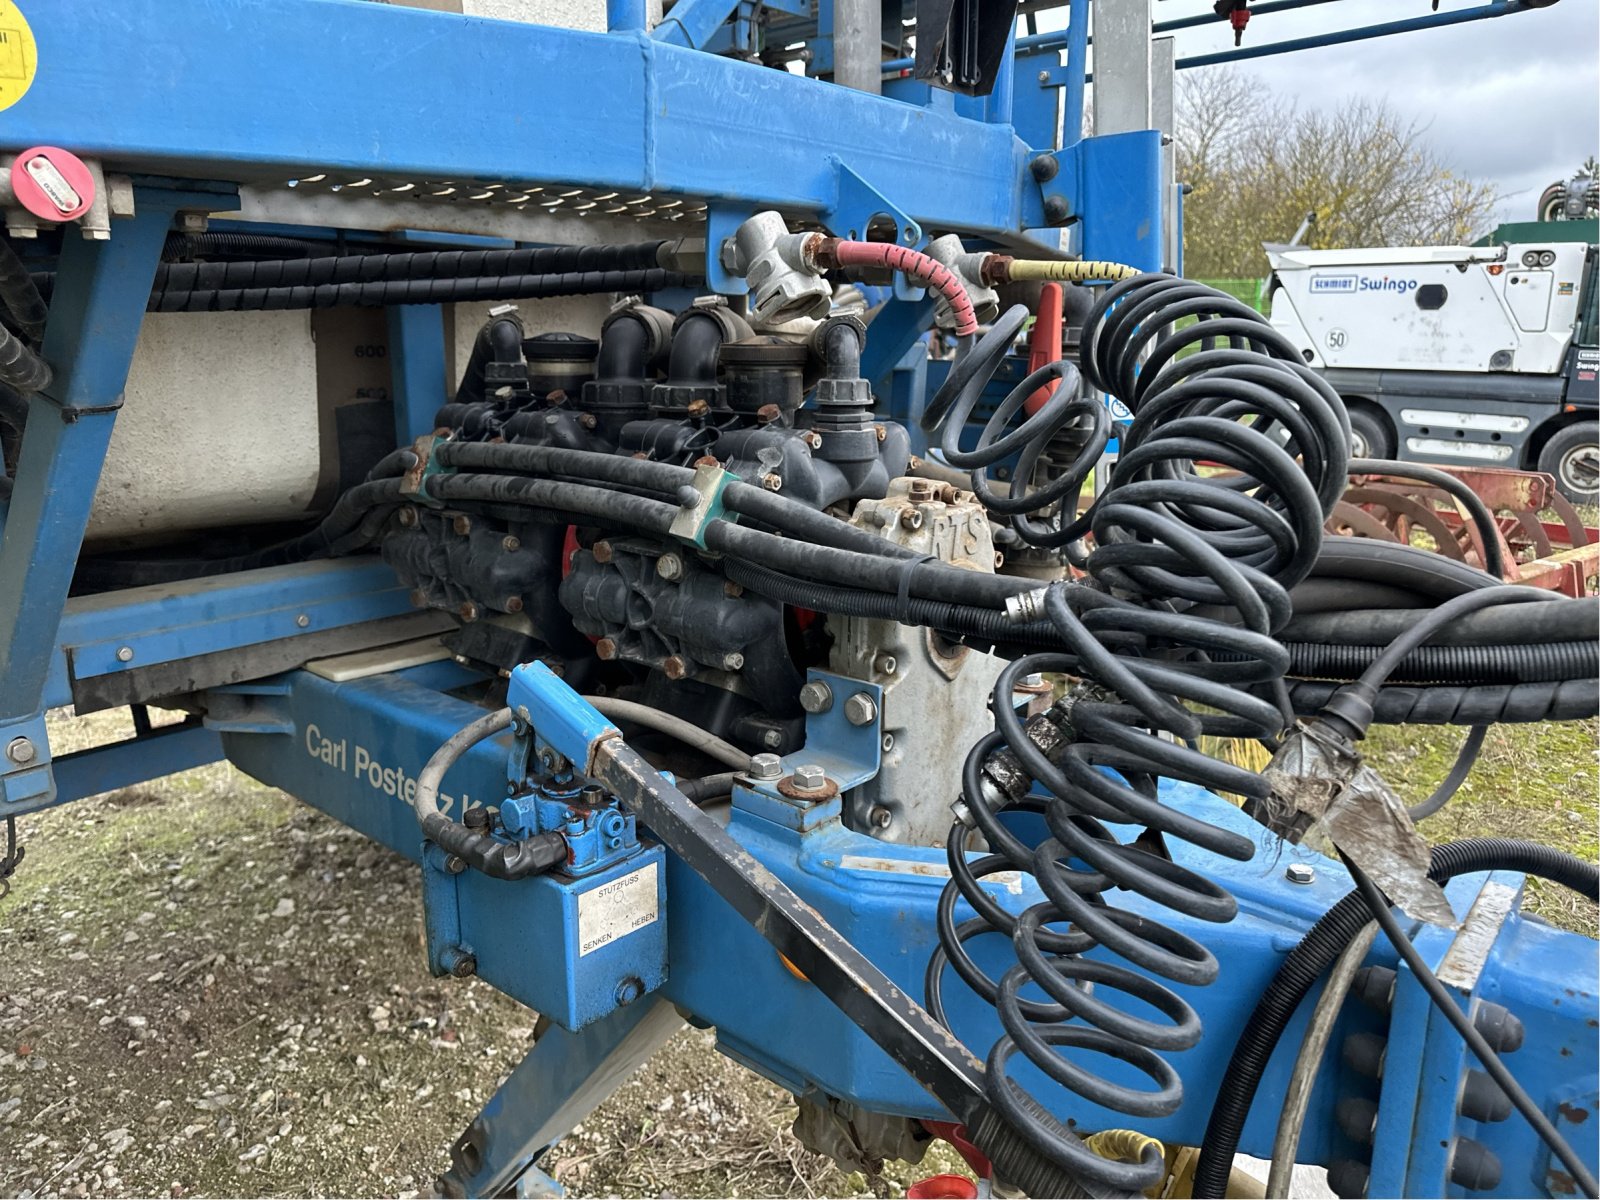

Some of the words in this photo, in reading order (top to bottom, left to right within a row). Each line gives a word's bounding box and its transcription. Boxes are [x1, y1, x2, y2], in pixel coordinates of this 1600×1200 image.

[1359, 276, 1417, 294] Swingo
[354, 344, 386, 358] 600
[1329, 332, 1345, 348] 50
[929, 508, 984, 563] RTS
[305, 723, 347, 772] Carl
[354, 744, 454, 824] Postez
[583, 932, 612, 952] SENKEN
[631, 912, 655, 928] HEBEN
